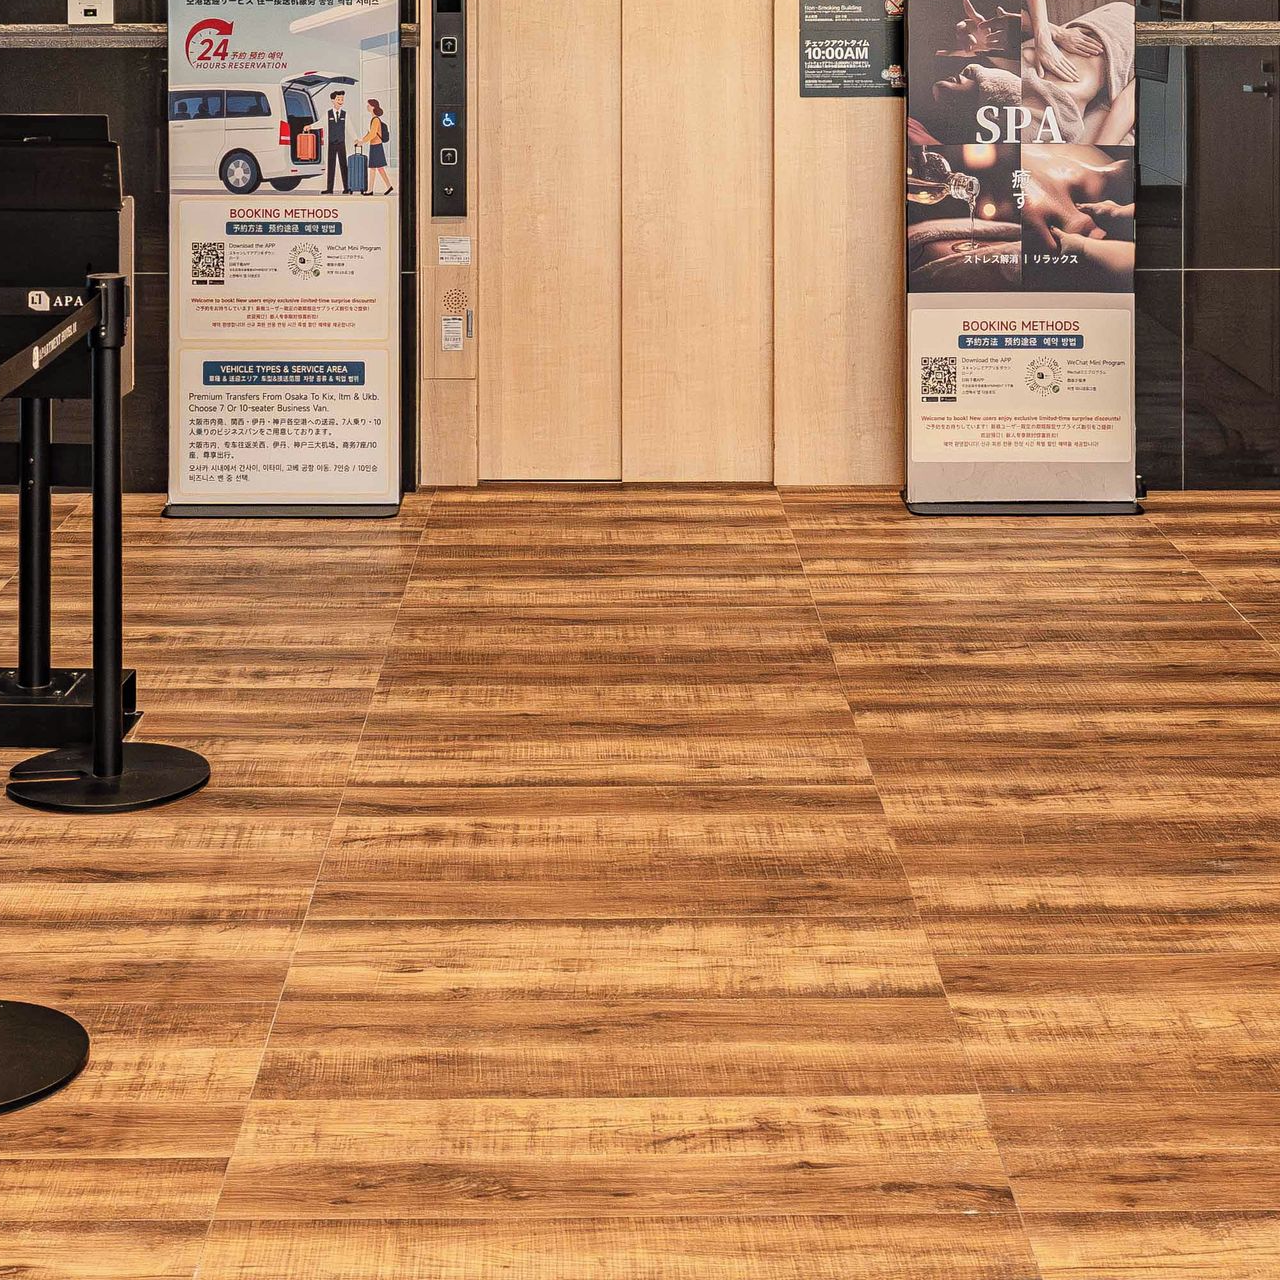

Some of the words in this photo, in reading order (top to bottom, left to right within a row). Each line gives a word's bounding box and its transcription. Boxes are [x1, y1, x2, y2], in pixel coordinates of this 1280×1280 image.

[197, 38, 229, 61] 24
[804, 47, 869, 60] 10:00AM
[975, 105, 1067, 144] SPA
[229, 208, 281, 219] BOOKING
[284, 208, 339, 219] METHODS
[232, 224, 264, 233] 予約方法
[304, 224, 319, 233] 예약
[360, 245, 382, 253] Program
[963, 254, 1019, 264] ストレス解消
[1033, 254, 1079, 264] リラックス
[962, 320, 1017, 331] BOOKING
[1021, 320, 1080, 331] METHODS
[39, 333, 62, 361] APARTMENT
[61, 324, 74, 343] HOTEL
[965, 337, 999, 346] 予約方法
[1043, 337, 1058, 346] 예약
[1102, 359, 1126, 367] Program
[220, 365, 254, 373] VEHICLE
[256, 365, 281, 373] TYPES
[283, 365, 290, 373] &
[291, 365, 325, 373] SERVICE
[326, 365, 348, 373] AREA
[188, 392, 223, 401] Premium
[226, 392, 260, 401] Transfers
[262, 392, 283, 401] From
[284, 392, 308, 401] Osaka
[311, 392, 320, 401] To
[322, 392, 336, 402] Kix,
[338, 392, 351, 401] Itm
[353, 392, 360, 401] &
[362, 392, 380, 401] Ukb.
[188, 404, 218, 412] Choose
[220, 404, 225, 412] 7
[227, 404, 237, 412] Or
[239, 404, 275, 412] 10-seater
[277, 404, 311, 412] Business
[312, 404, 329, 412] Van.
[189, 464, 209, 472] 오사카
[211, 464, 237, 472] 시내에서
[189, 474, 215, 482] 비즈니스
